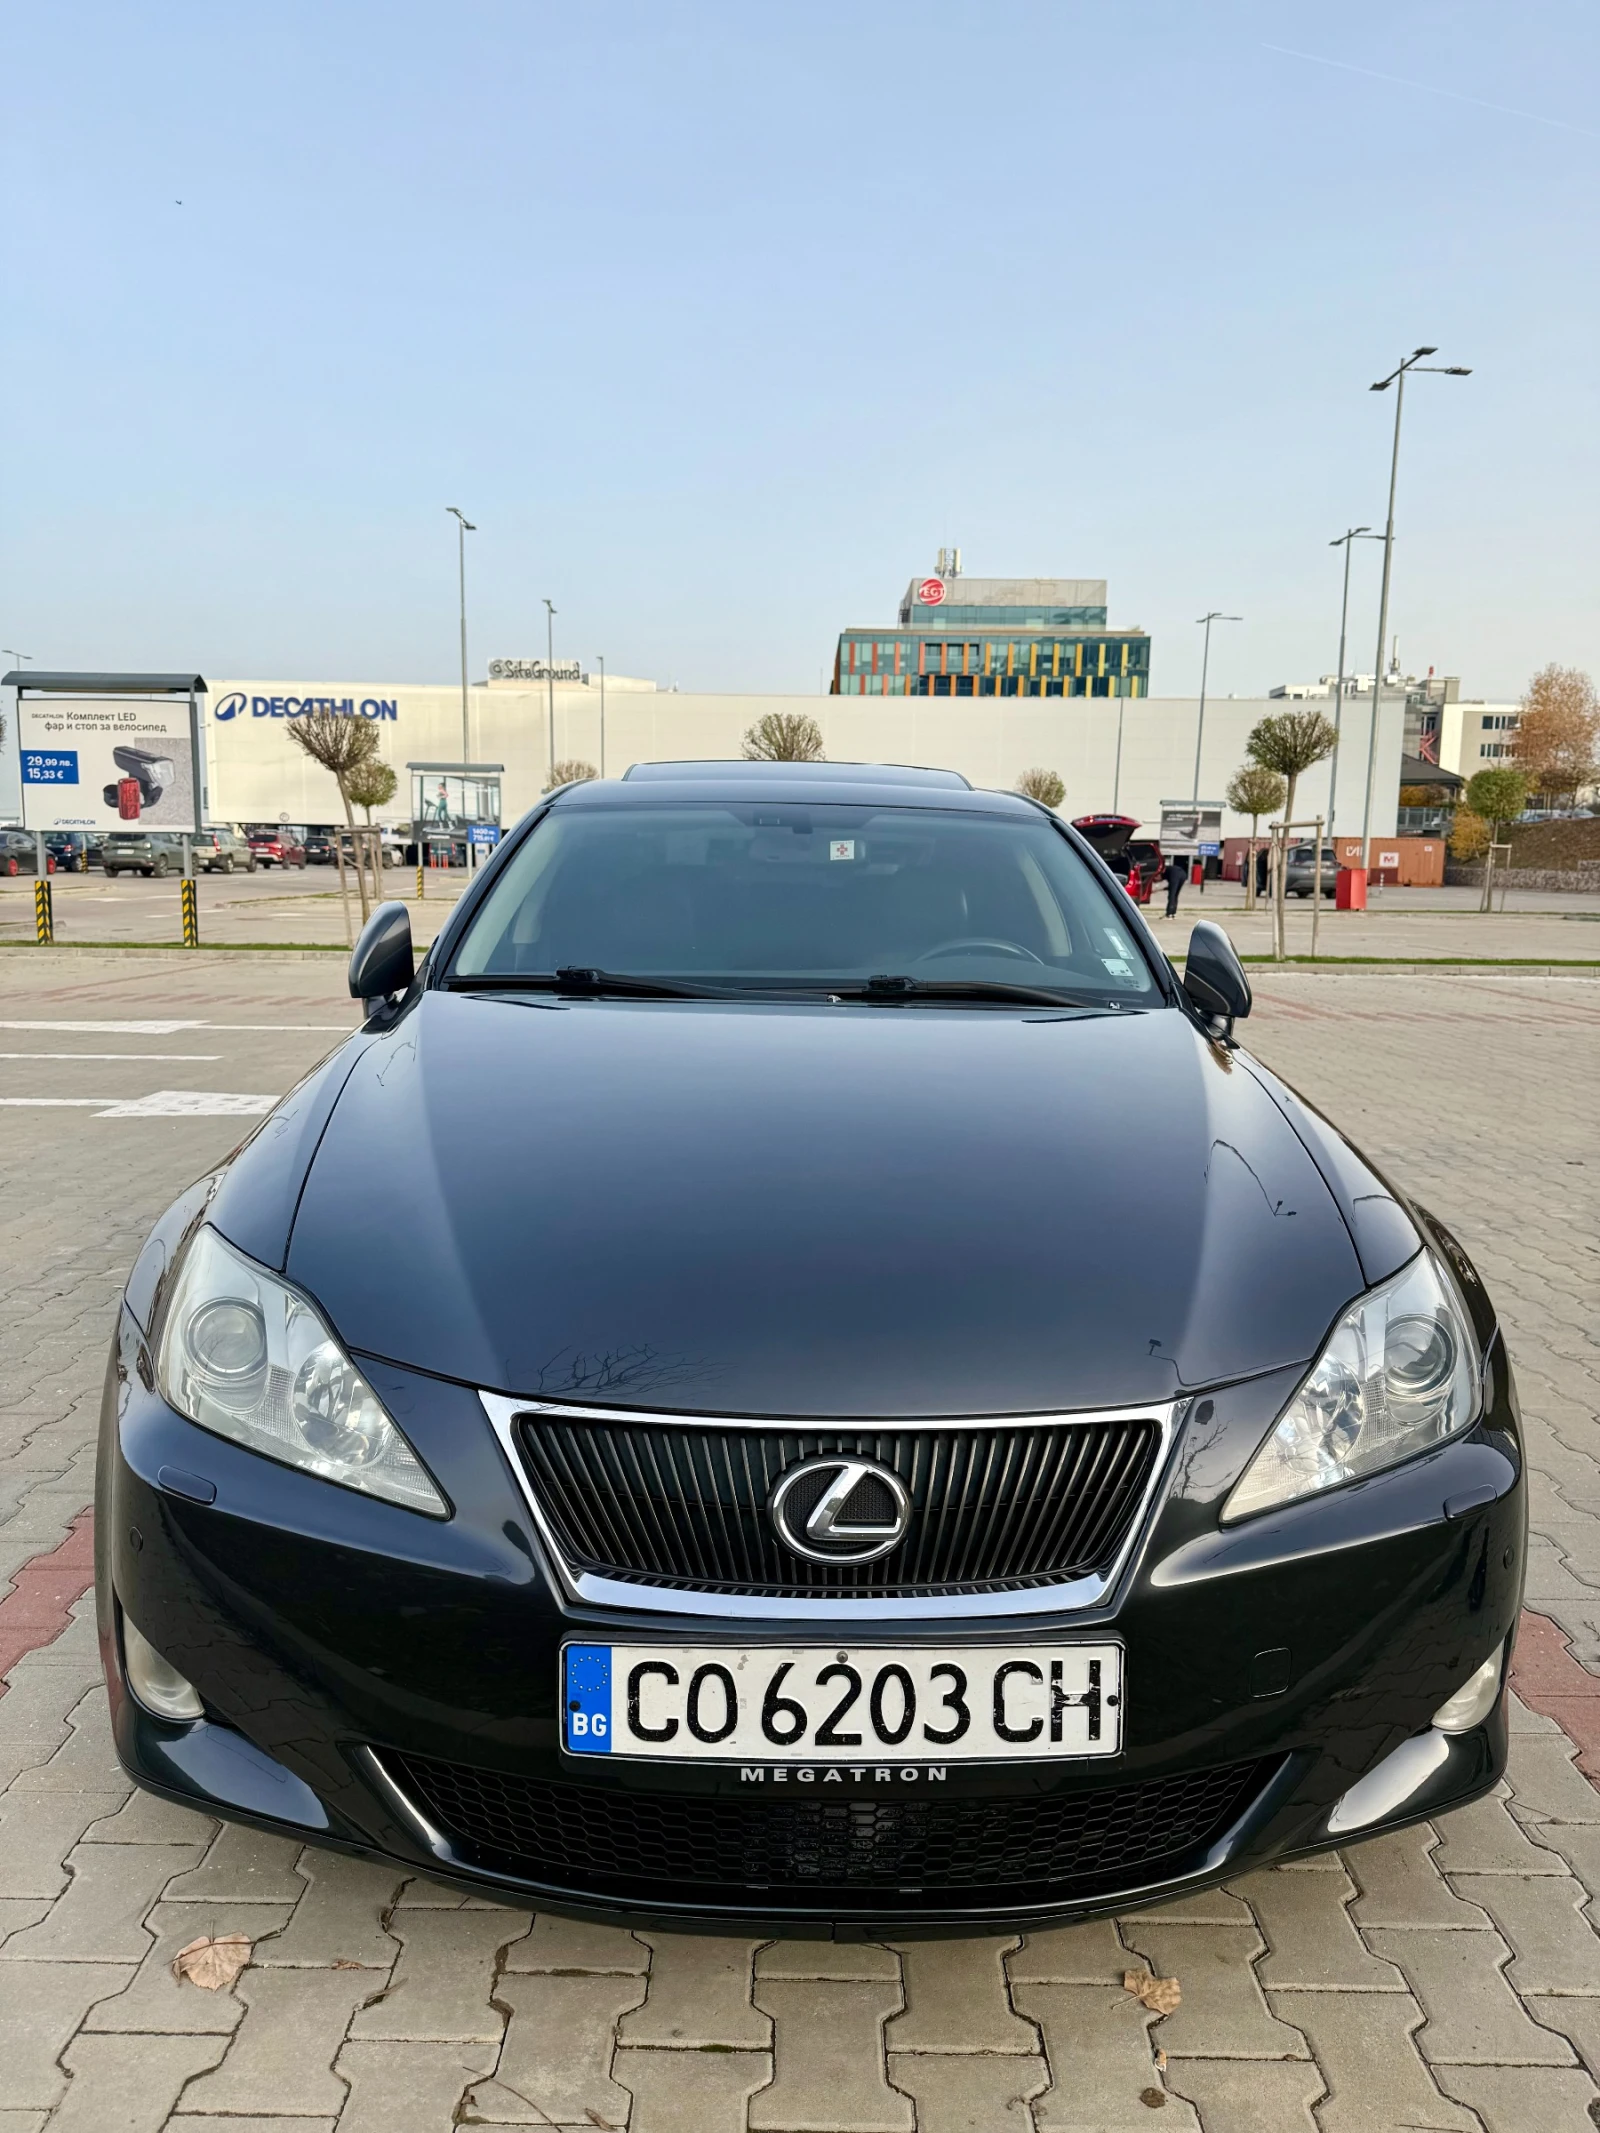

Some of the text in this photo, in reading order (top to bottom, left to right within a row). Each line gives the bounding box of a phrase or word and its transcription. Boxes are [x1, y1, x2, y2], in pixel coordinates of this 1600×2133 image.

[504, 659, 580, 680] SiteGround
[251, 696, 398, 721] DECATHLON
[66, 711, 137, 721] Комплект LED
[44, 721, 65, 732] фар
[75, 723, 98, 731] стоп
[99, 723, 111, 731] за
[113, 723, 167, 733] велосипед
[27, 755, 58, 768] 29,99
[27, 767, 64, 780] 15,33 €
[572, 1659, 1101, 1746] BG CO 6203 CH
[740, 1767, 948, 1783] MEGATRON
